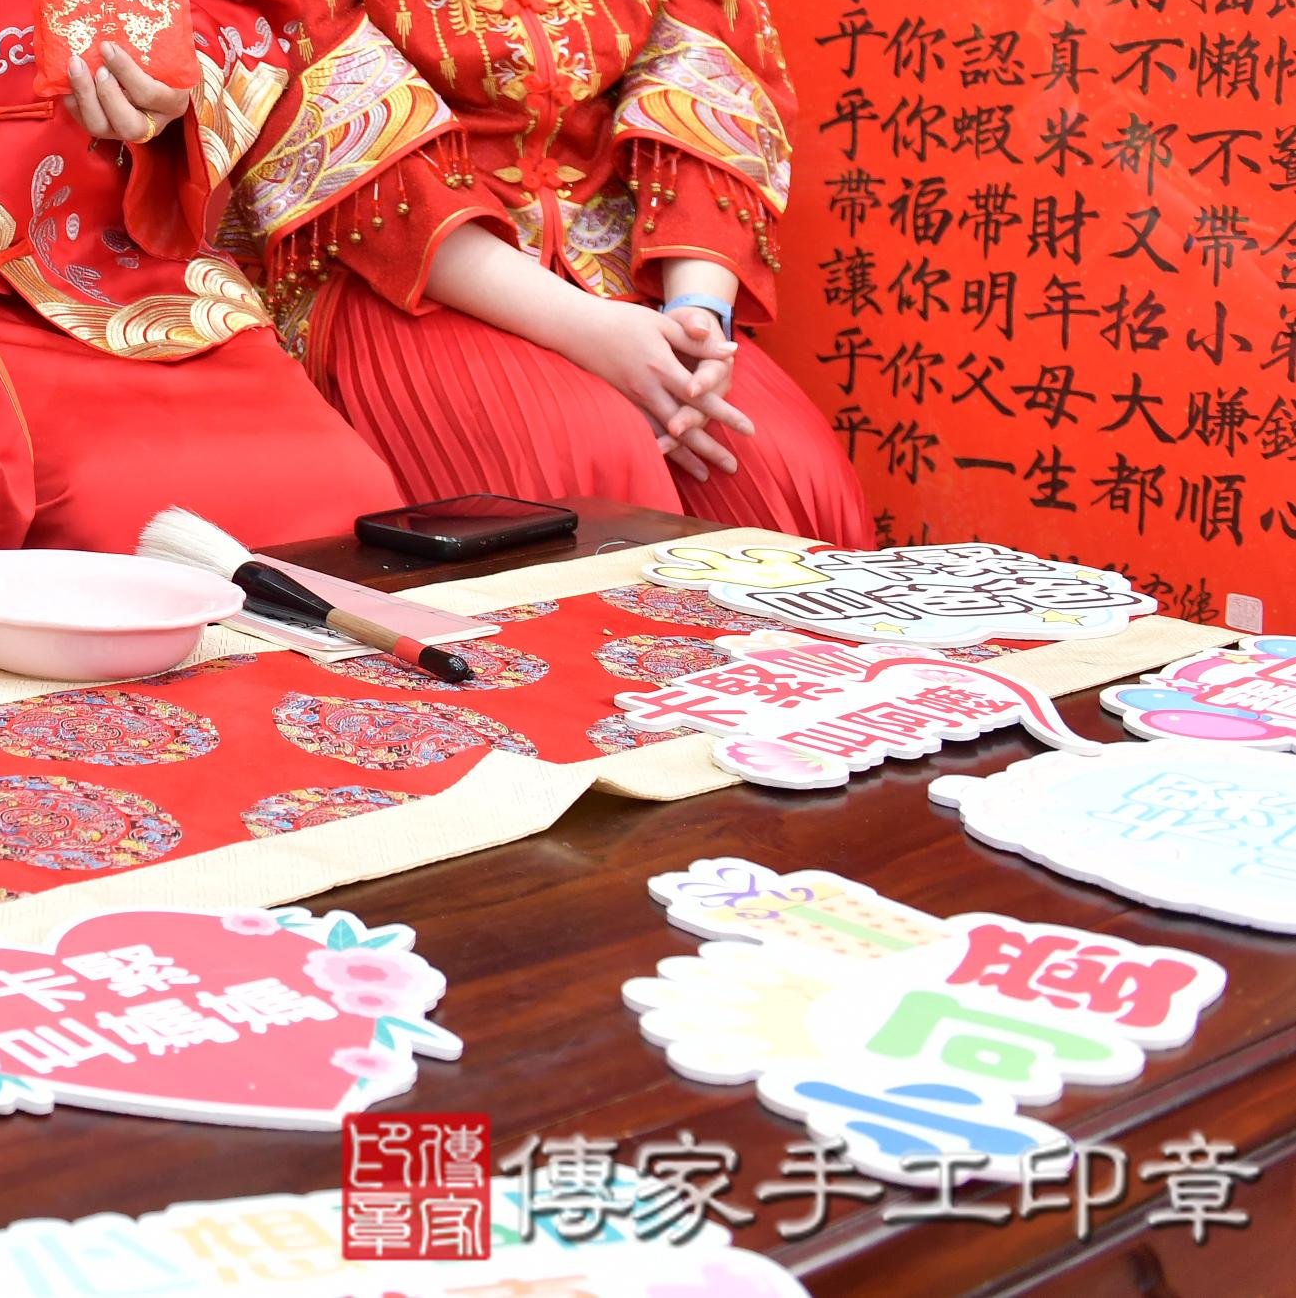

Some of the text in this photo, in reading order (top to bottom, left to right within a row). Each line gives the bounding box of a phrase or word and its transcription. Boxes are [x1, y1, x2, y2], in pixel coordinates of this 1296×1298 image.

[746, 577, 1142, 620] 叫爸爸
[628, 663, 844, 727] 卡緊
